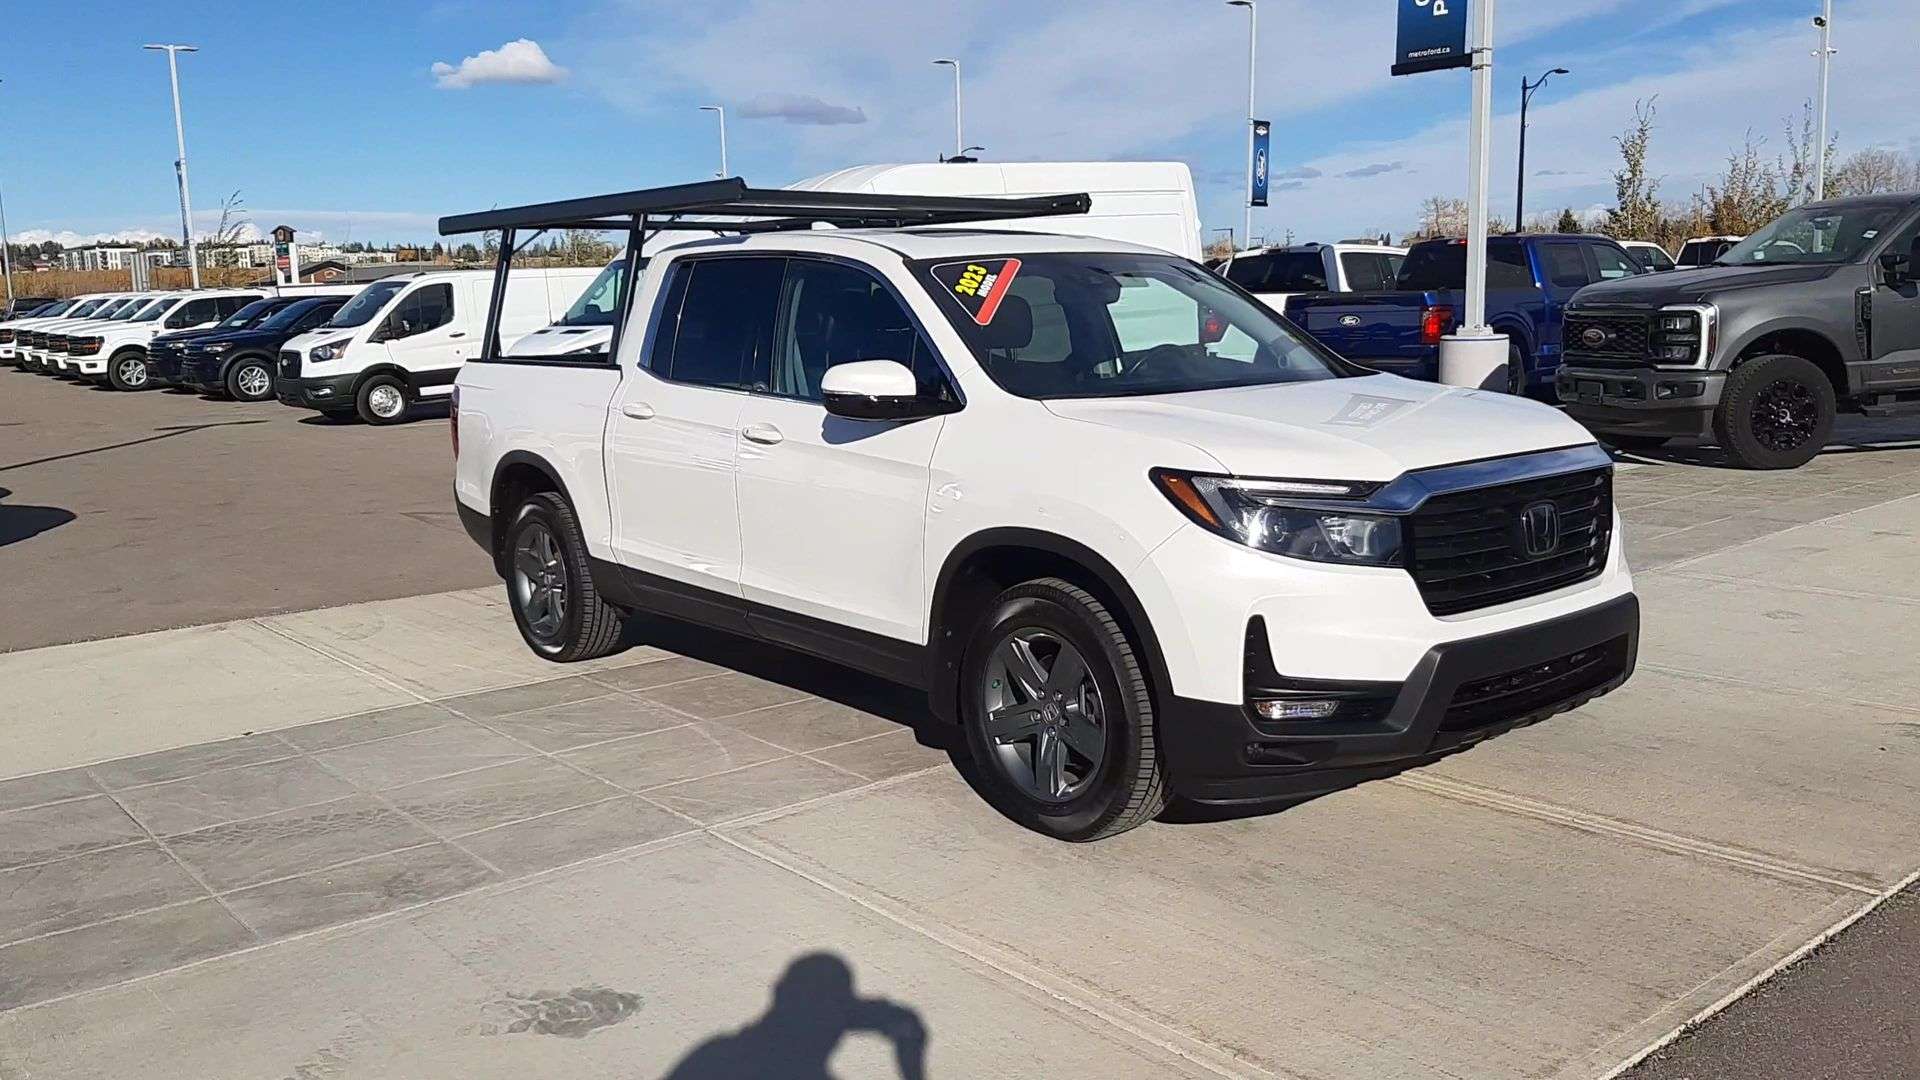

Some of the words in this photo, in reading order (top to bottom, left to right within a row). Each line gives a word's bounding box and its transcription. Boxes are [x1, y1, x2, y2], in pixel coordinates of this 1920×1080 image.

[1408, 46, 1451, 58] metroford.ca
[954, 264, 987, 297] 2023
[976, 273, 998, 298] MODEL
